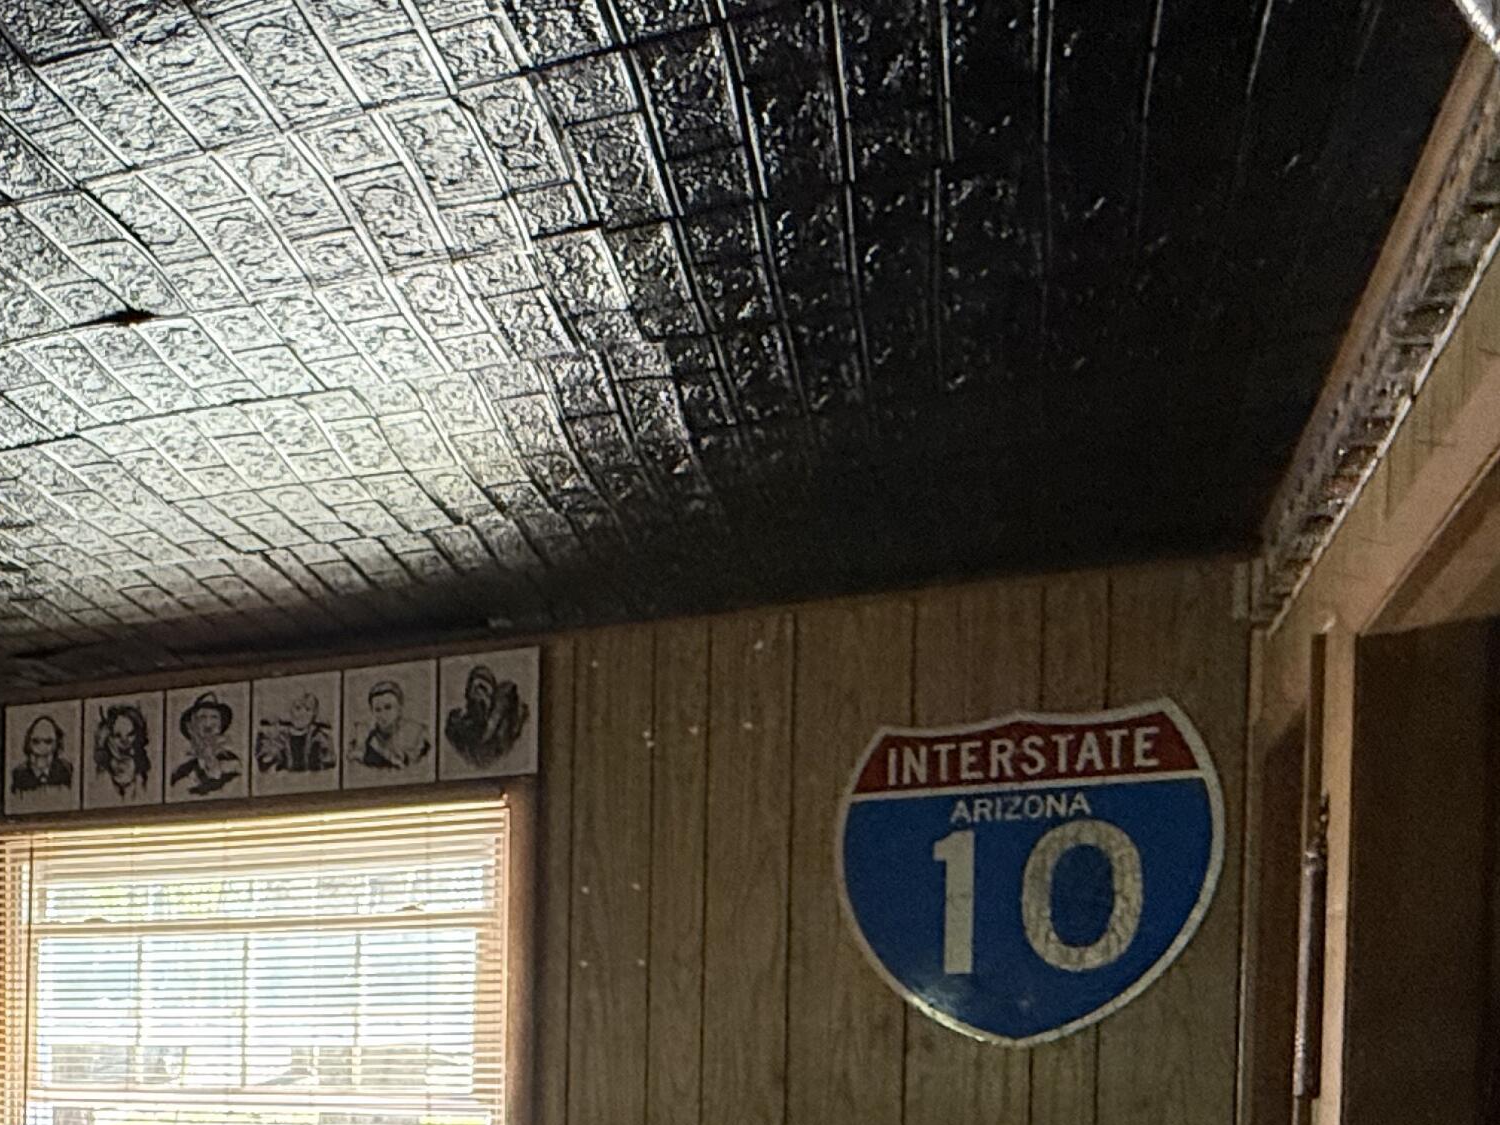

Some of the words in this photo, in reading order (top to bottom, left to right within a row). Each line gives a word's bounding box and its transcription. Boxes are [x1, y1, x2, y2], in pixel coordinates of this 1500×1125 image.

[887, 726, 1161, 786] INTERSTATE
[950, 791, 1092, 824] ARIZONA
[932, 819, 1145, 976] 10
